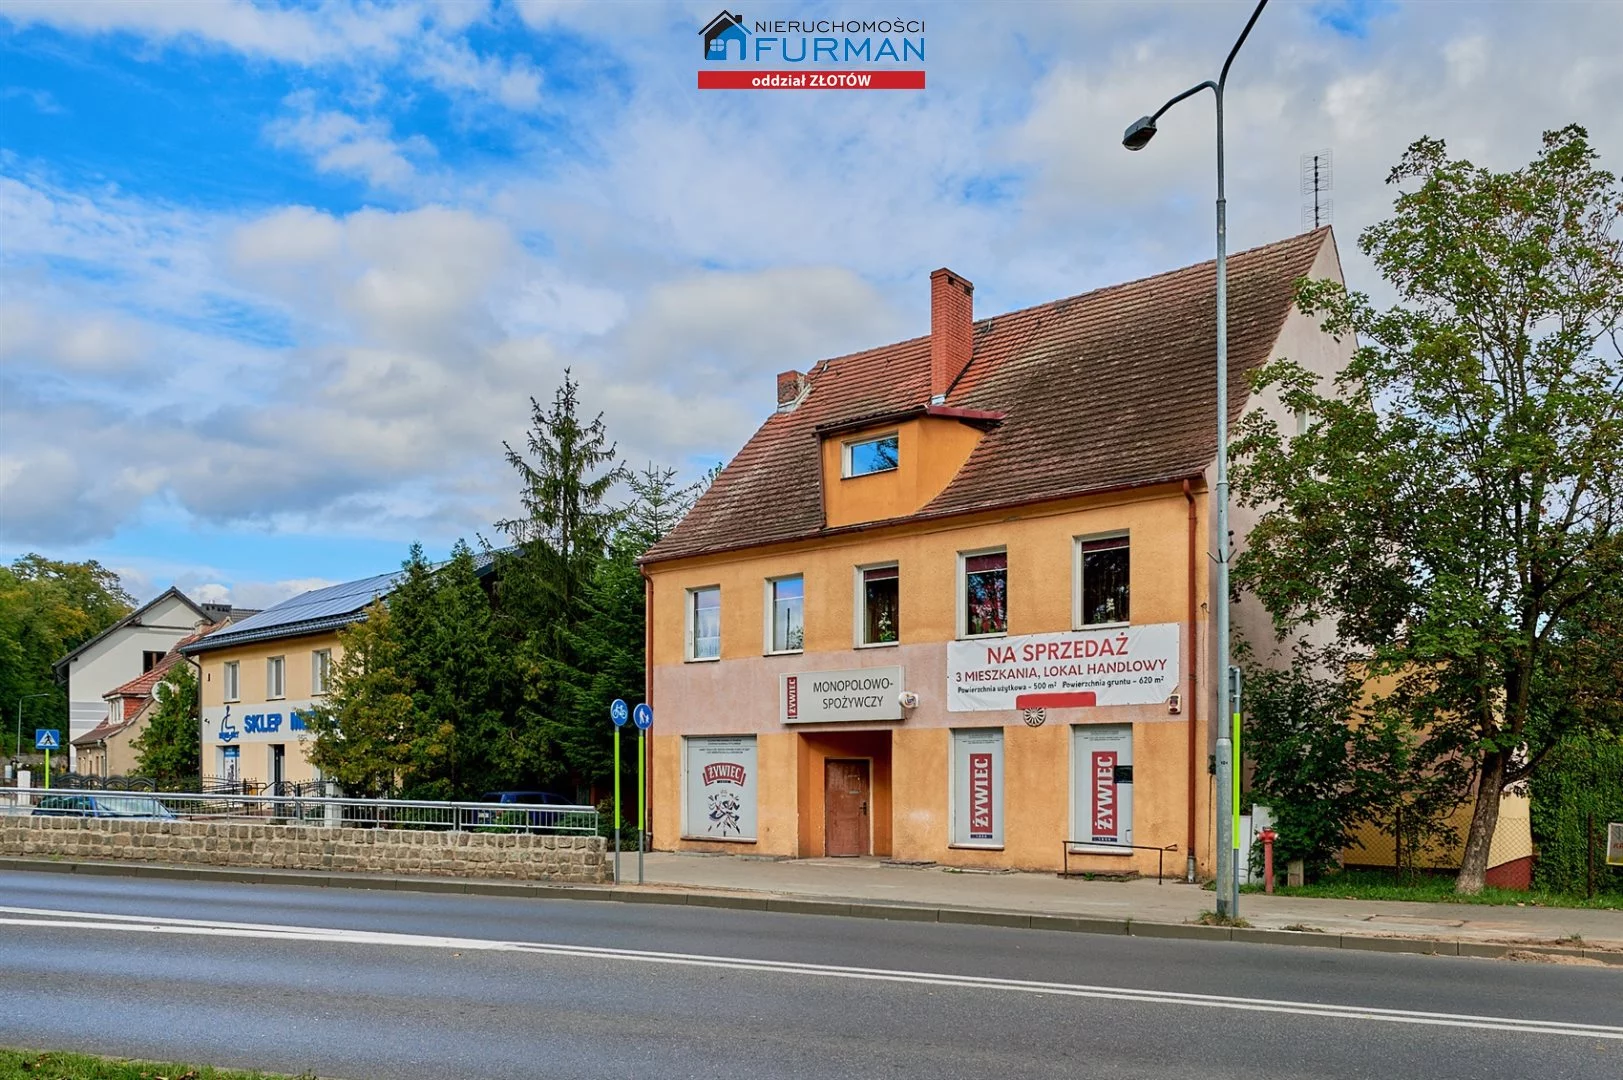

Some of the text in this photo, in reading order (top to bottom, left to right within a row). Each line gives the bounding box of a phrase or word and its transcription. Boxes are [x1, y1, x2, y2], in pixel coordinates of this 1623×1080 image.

[987, 632, 1129, 664] NA SPRZEDAŻ
[955, 659, 1168, 682] 3 MIESZKANIA, LOKAL HANDLOWY
[788, 678, 796, 714] ŻYWIEC
[813, 677, 894, 693] MONOPOLOWO-
[957, 684, 996, 694] Powierzchnia
[997, 683, 1027, 693] użytkowa
[1033, 682, 1046, 690] 500
[1062, 679, 1106, 689] Powierzchnia
[1107, 678, 1131, 688] gruntu
[1138, 676, 1153, 684] 620
[822, 695, 884, 709] SPOŻYWCZY
[244, 712, 283, 733] SKLEP
[708, 764, 742, 779] ŻYWIEC
[972, 758, 989, 828] ŻYWIEC
[1094, 756, 1113, 830] ŻYWIEC
